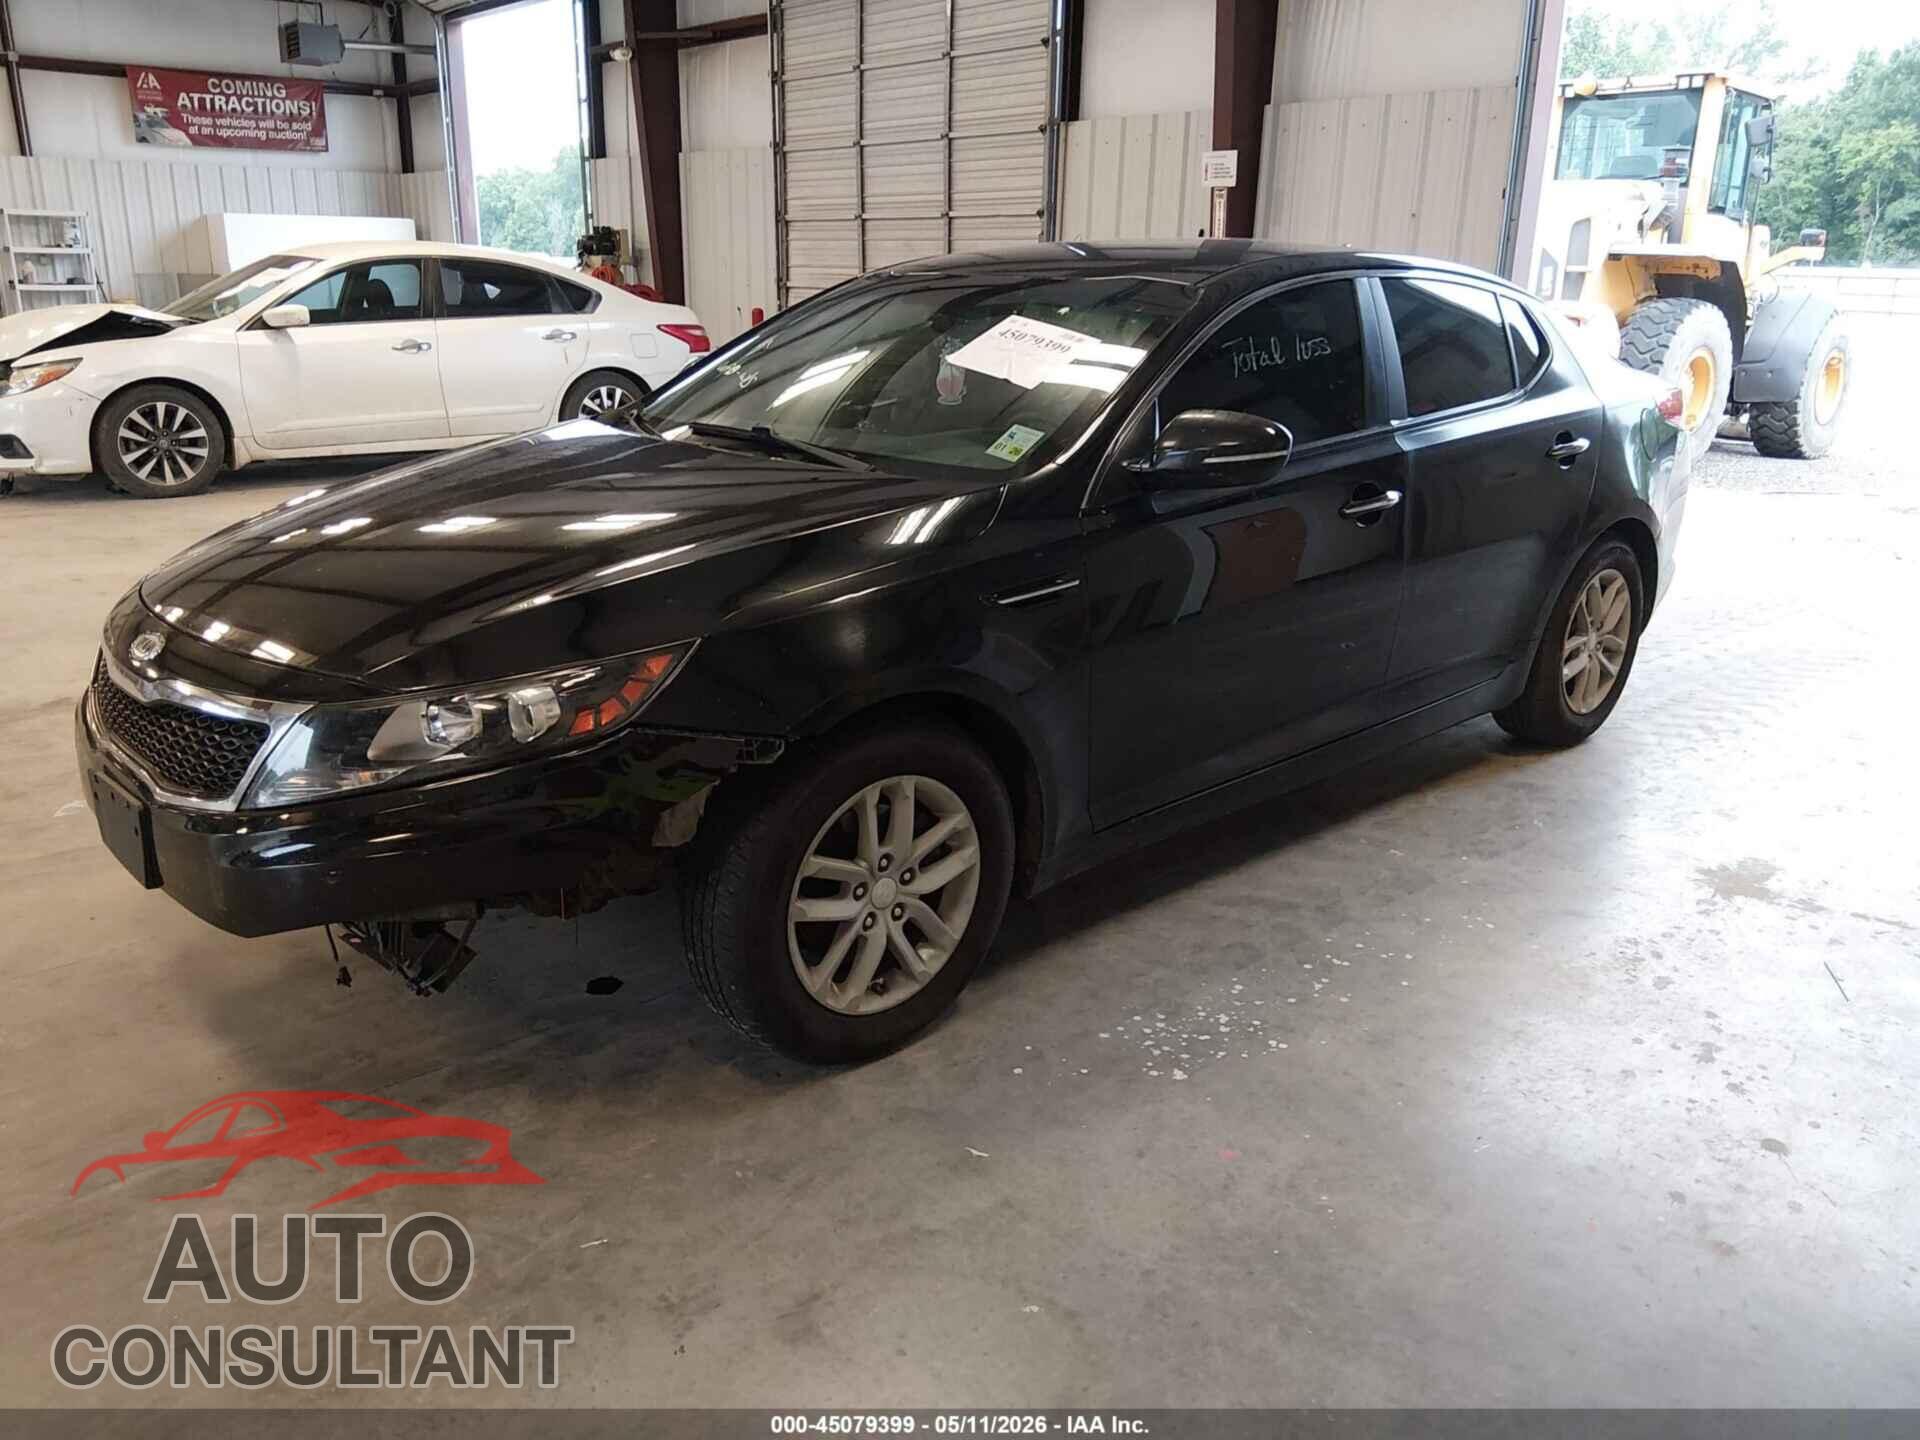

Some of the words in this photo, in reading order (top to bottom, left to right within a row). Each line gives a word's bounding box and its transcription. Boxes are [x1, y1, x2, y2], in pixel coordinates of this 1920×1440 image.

[207, 78, 287, 98] COMING
[177, 92, 317, 117] ATTRACTIONS!
[181, 113, 213, 126] These
[215, 117, 256, 129] vehicles
[258, 119, 275, 129] will
[277, 119, 289, 130] be
[291, 120, 312, 131] sold
[189, 125, 199, 135] at
[201, 126, 214, 136] an
[216, 128, 266, 141] upcoming
[268, 129, 307, 141] auction!
[1221, 336, 1286, 378] Total
